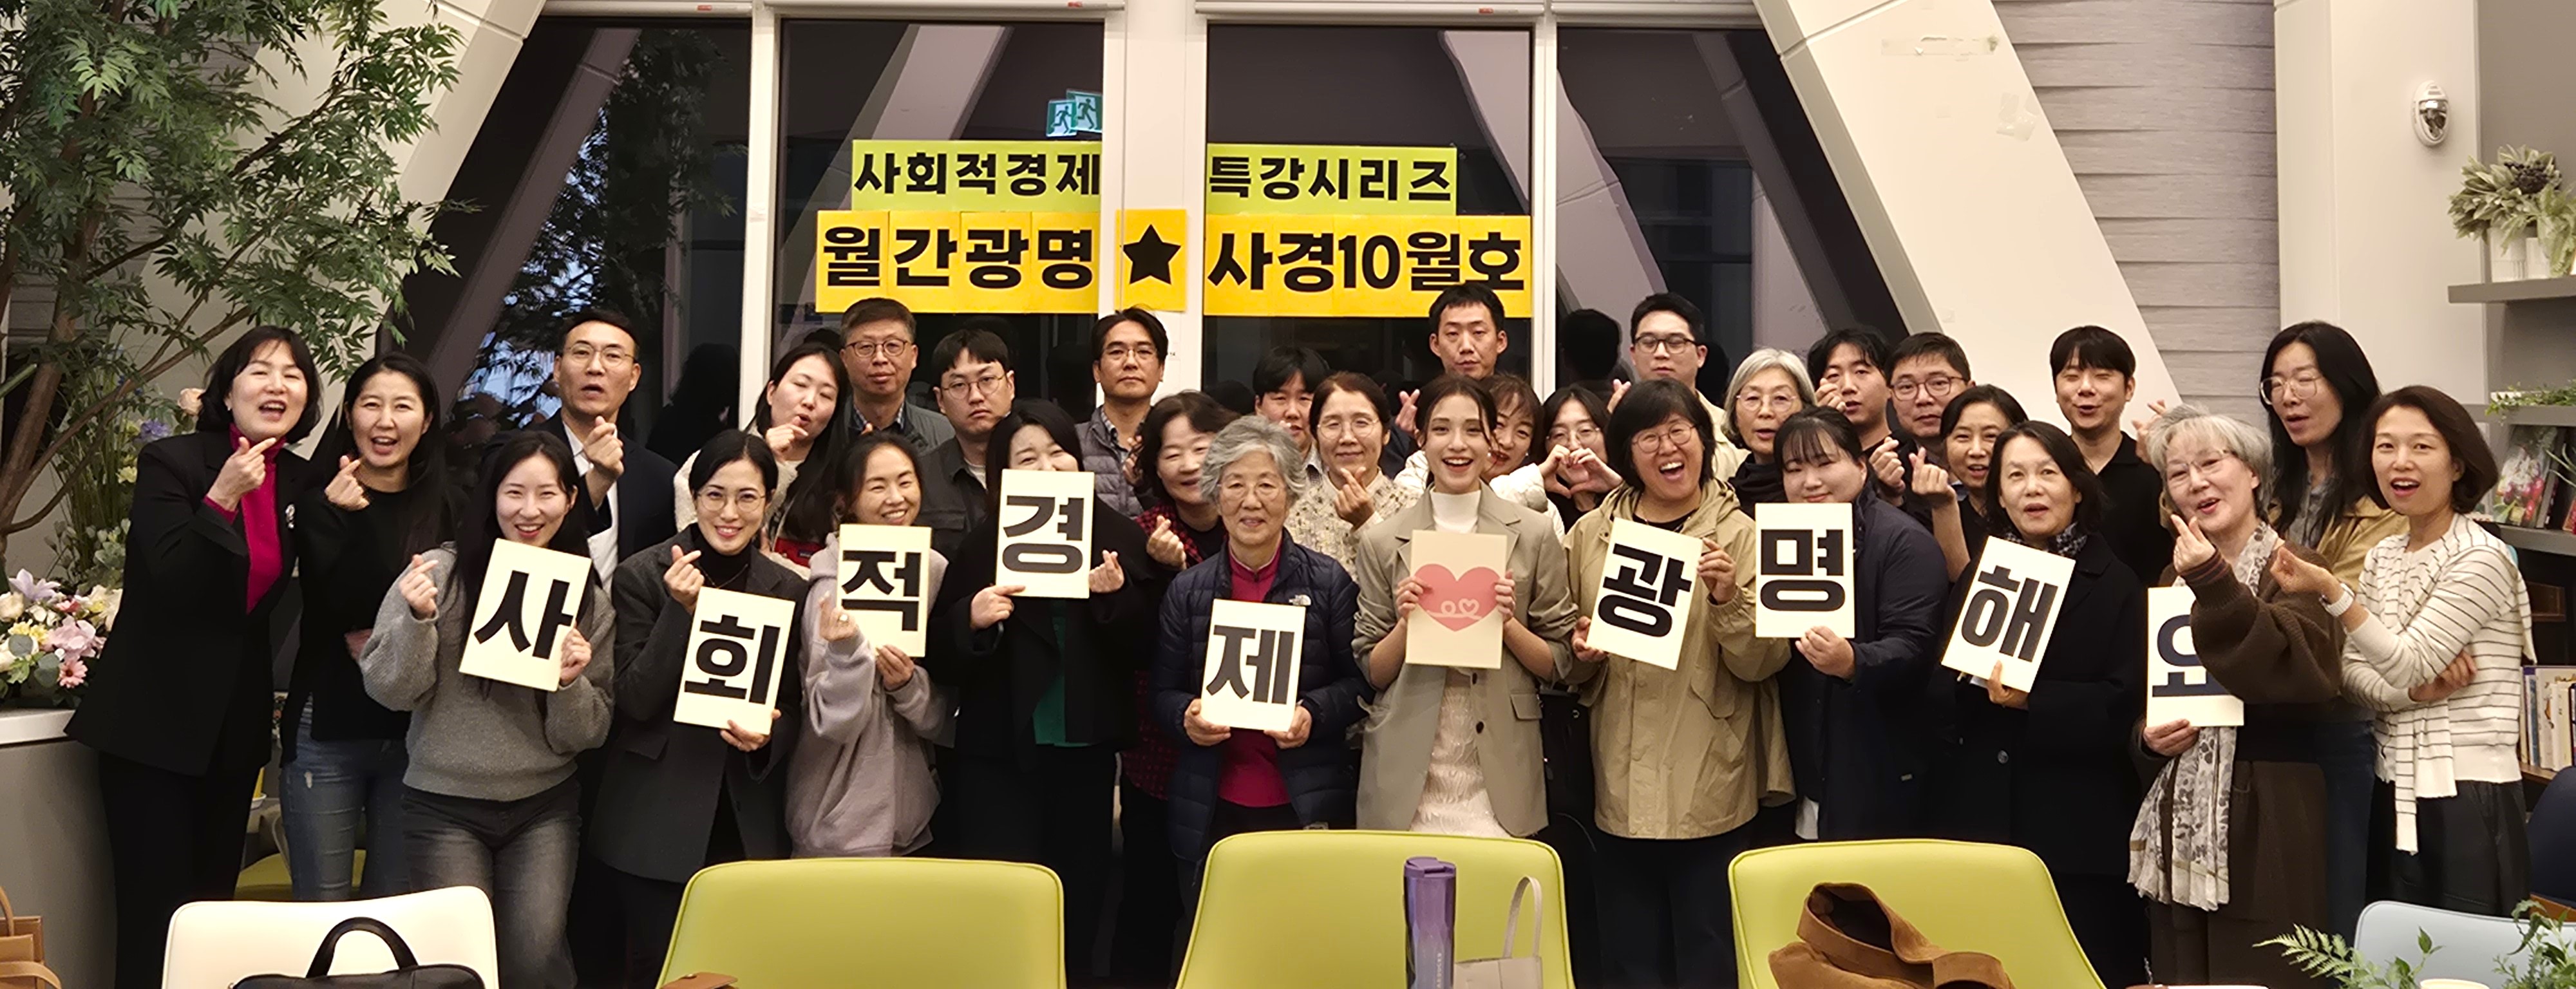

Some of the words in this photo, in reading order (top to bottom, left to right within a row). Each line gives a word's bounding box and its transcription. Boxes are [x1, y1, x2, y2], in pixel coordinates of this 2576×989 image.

[855, 152, 1100, 196] 사회적경제
[1209, 156, 1451, 201] 특강시리즈
[824, 227, 1092, 289] 월간광명
[1208, 232, 1524, 292] 사경10월호
[1002, 495, 1084, 574] 경
[1760, 529, 1845, 612] 명
[475, 570, 573, 660] 사
[841, 550, 922, 632] 적
[1598, 543, 1692, 637] 광
[1962, 565, 2058, 662] 해
[684, 614, 781, 705] 회
[1206, 625, 1295, 705] 제
